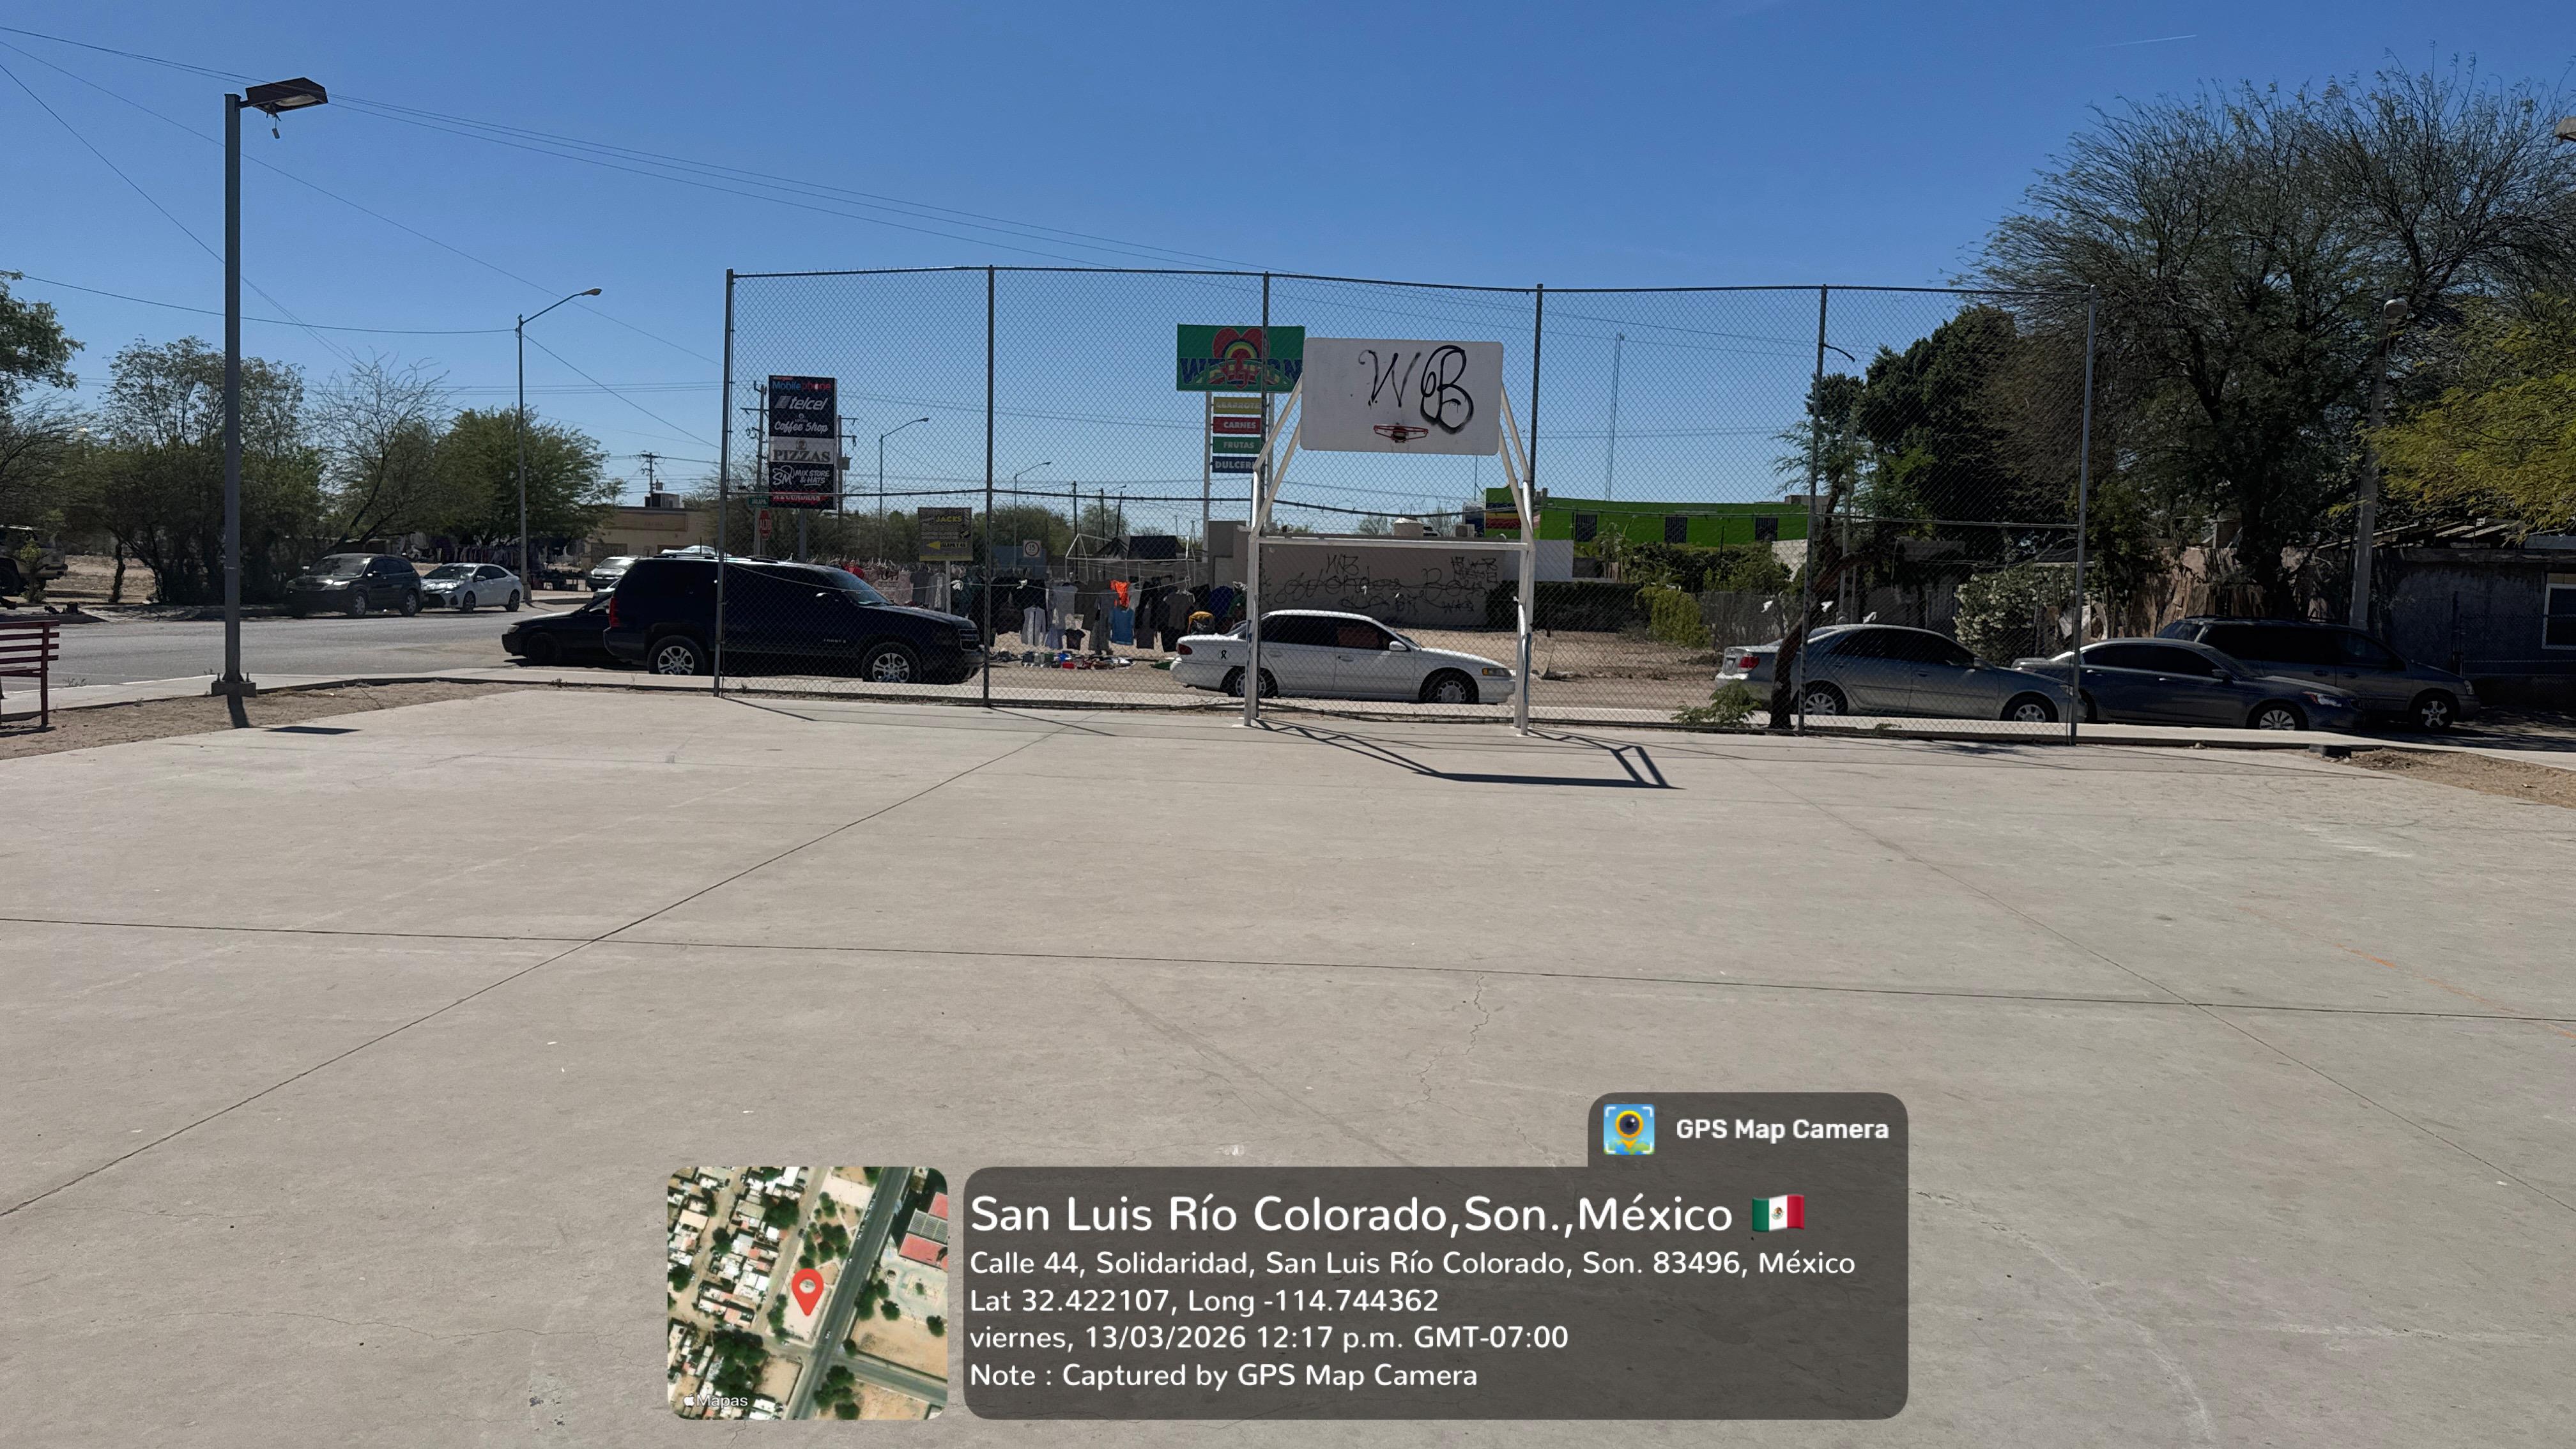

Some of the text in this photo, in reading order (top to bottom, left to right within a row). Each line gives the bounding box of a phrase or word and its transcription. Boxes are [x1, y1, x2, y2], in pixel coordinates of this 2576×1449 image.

[802, 381, 831, 391] phne
[789, 396, 829, 410] telcel
[774, 420, 829, 434] Coffee Shop
[773, 449, 831, 462] PIZZAS
[1215, 461, 1254, 469] DULCER
